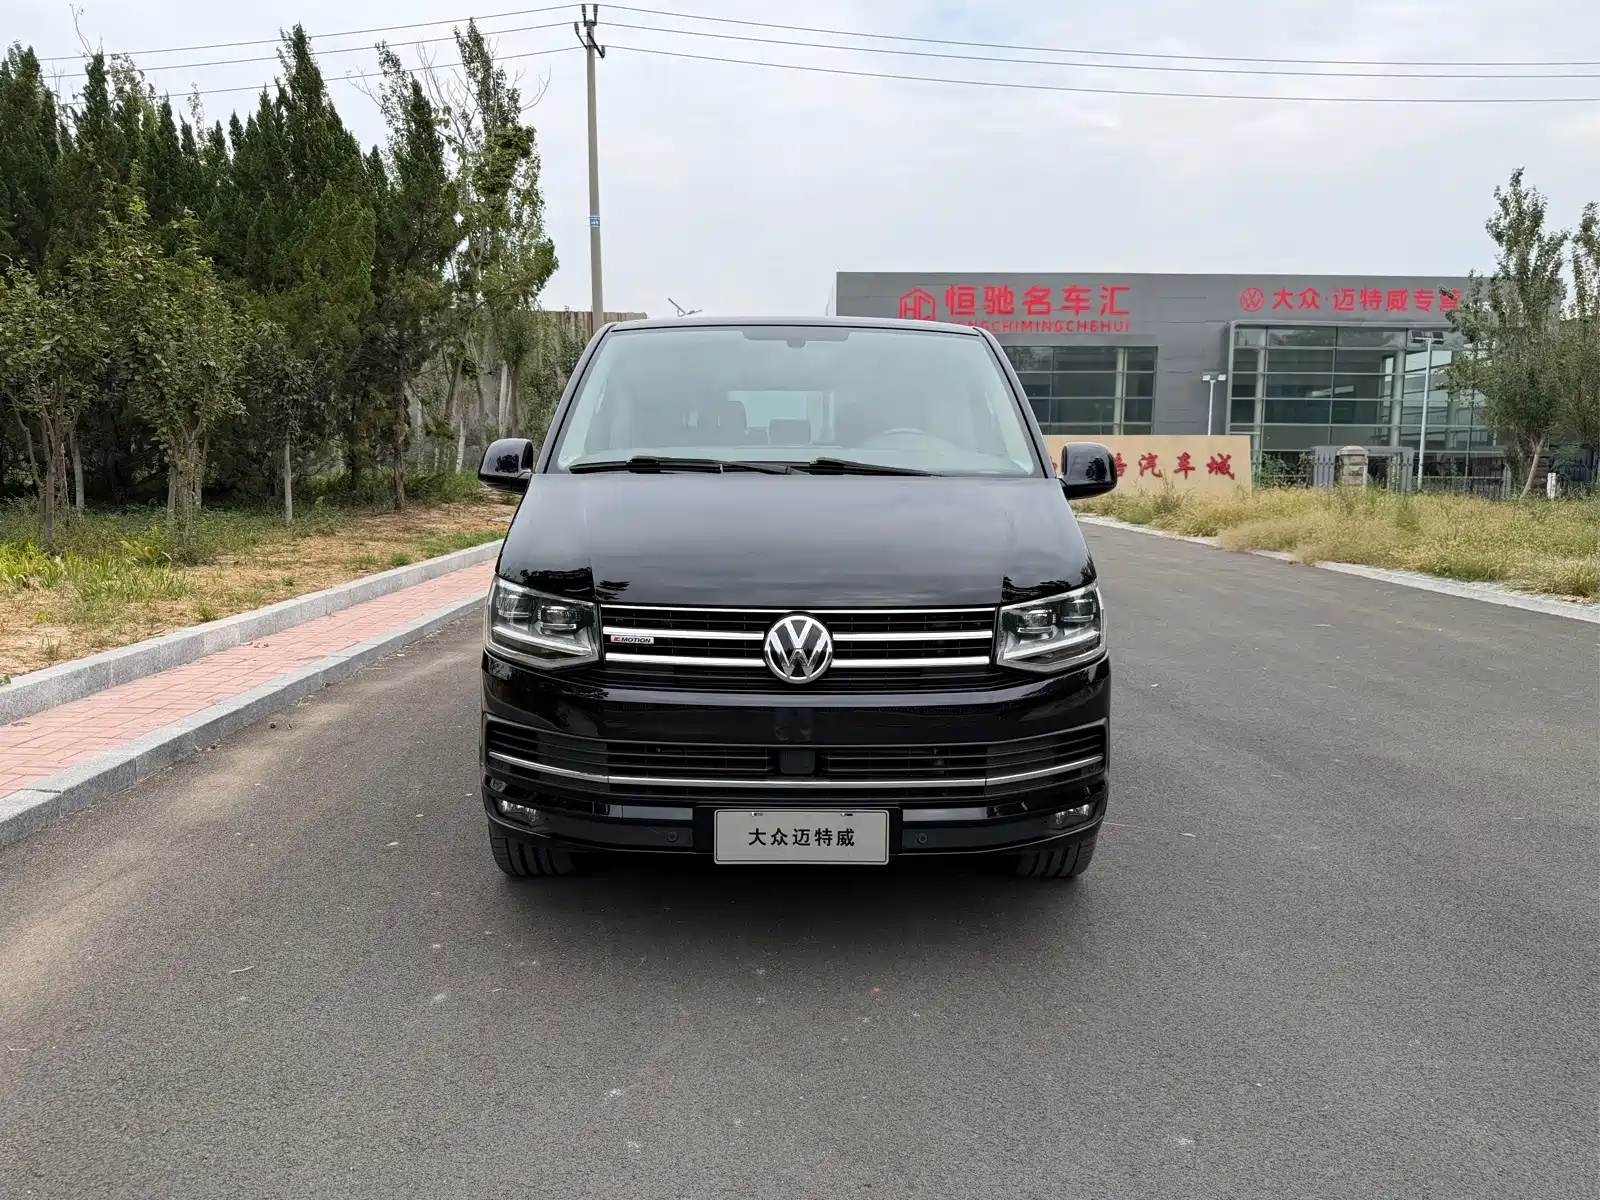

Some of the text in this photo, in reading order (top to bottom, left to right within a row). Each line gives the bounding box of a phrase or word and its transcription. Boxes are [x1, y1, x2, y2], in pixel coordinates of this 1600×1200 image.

[945, 284, 1130, 316] 恒驰名车汇
[947, 319, 1129, 333] NGCHIMINGCHEHUI
[748, 827, 855, 847] 大众迈特威
